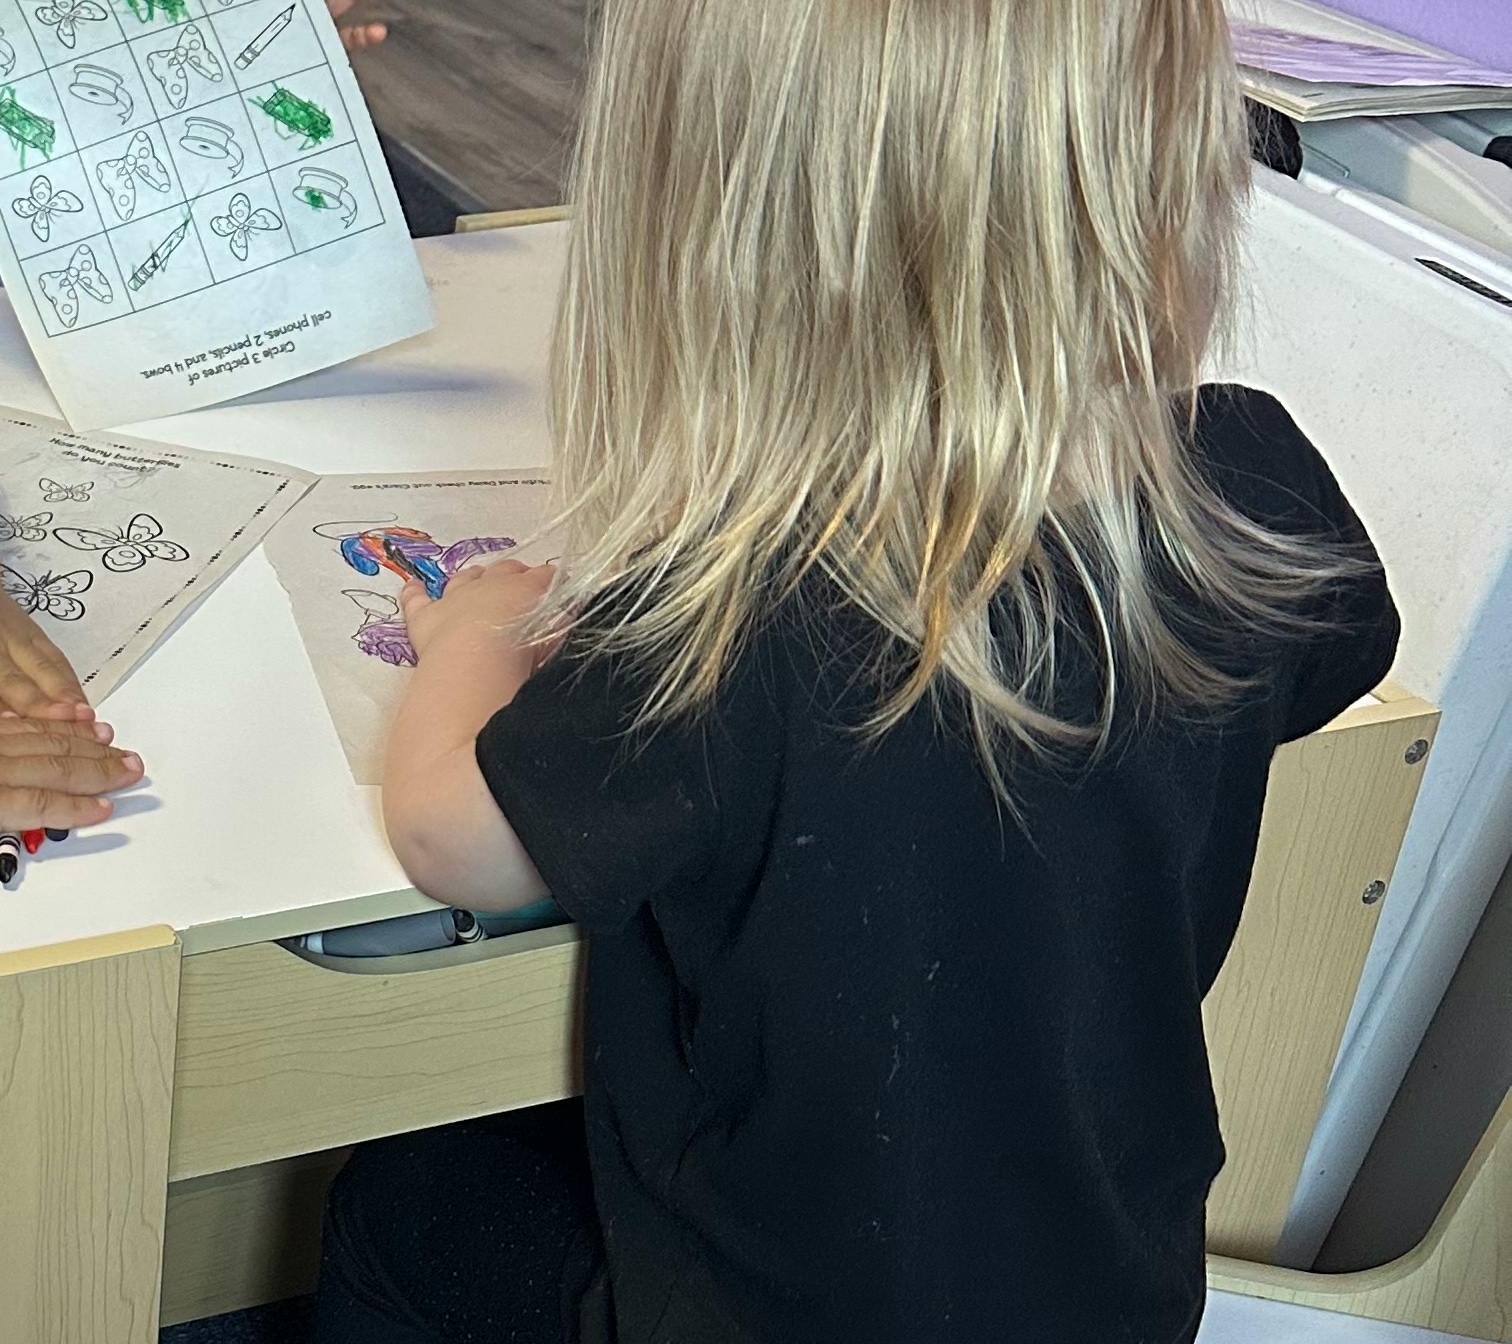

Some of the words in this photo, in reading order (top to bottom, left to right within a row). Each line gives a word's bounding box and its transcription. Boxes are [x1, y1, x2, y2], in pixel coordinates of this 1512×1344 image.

[264, 313, 310, 340] phones,
[312, 310, 332, 328] cell
[208, 334, 252, 359] pencils,
[254, 334, 264, 347] 2
[263, 340, 295, 358] Circle
[184, 353, 207, 369] and
[203, 352, 250, 378] pictures
[252, 352, 262, 364] 3
[140, 364, 173, 380] bows.
[176, 361, 185, 373] 4
[189, 372, 200, 386] of
[49, 437, 76, 448] How
[77, 444, 113, 458] many
[113, 453, 181, 469] butterflies
[80, 455, 106, 466] you
